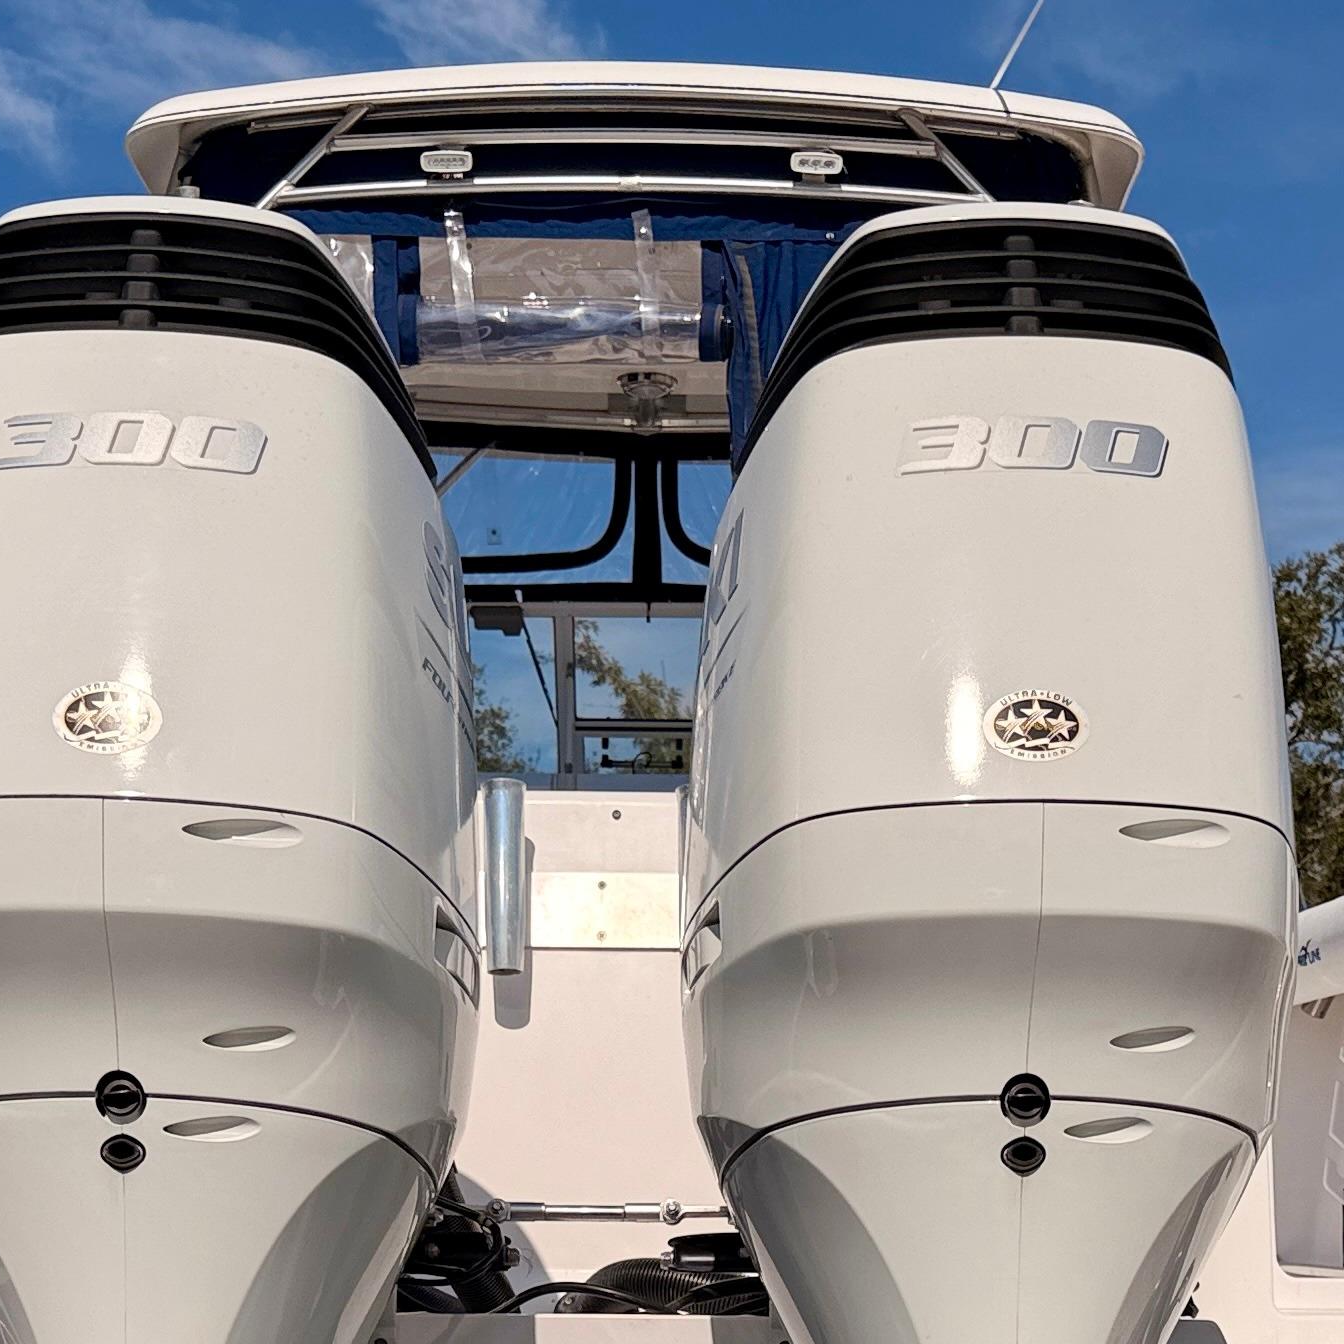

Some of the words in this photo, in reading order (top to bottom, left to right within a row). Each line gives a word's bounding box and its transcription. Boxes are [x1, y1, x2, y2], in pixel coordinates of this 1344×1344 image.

[897, 415, 1169, 477] 300
[71, 681, 109, 698] ULTRA
[1000, 690, 1037, 706] ULTRA
[1046, 691, 1073, 706] LOW
